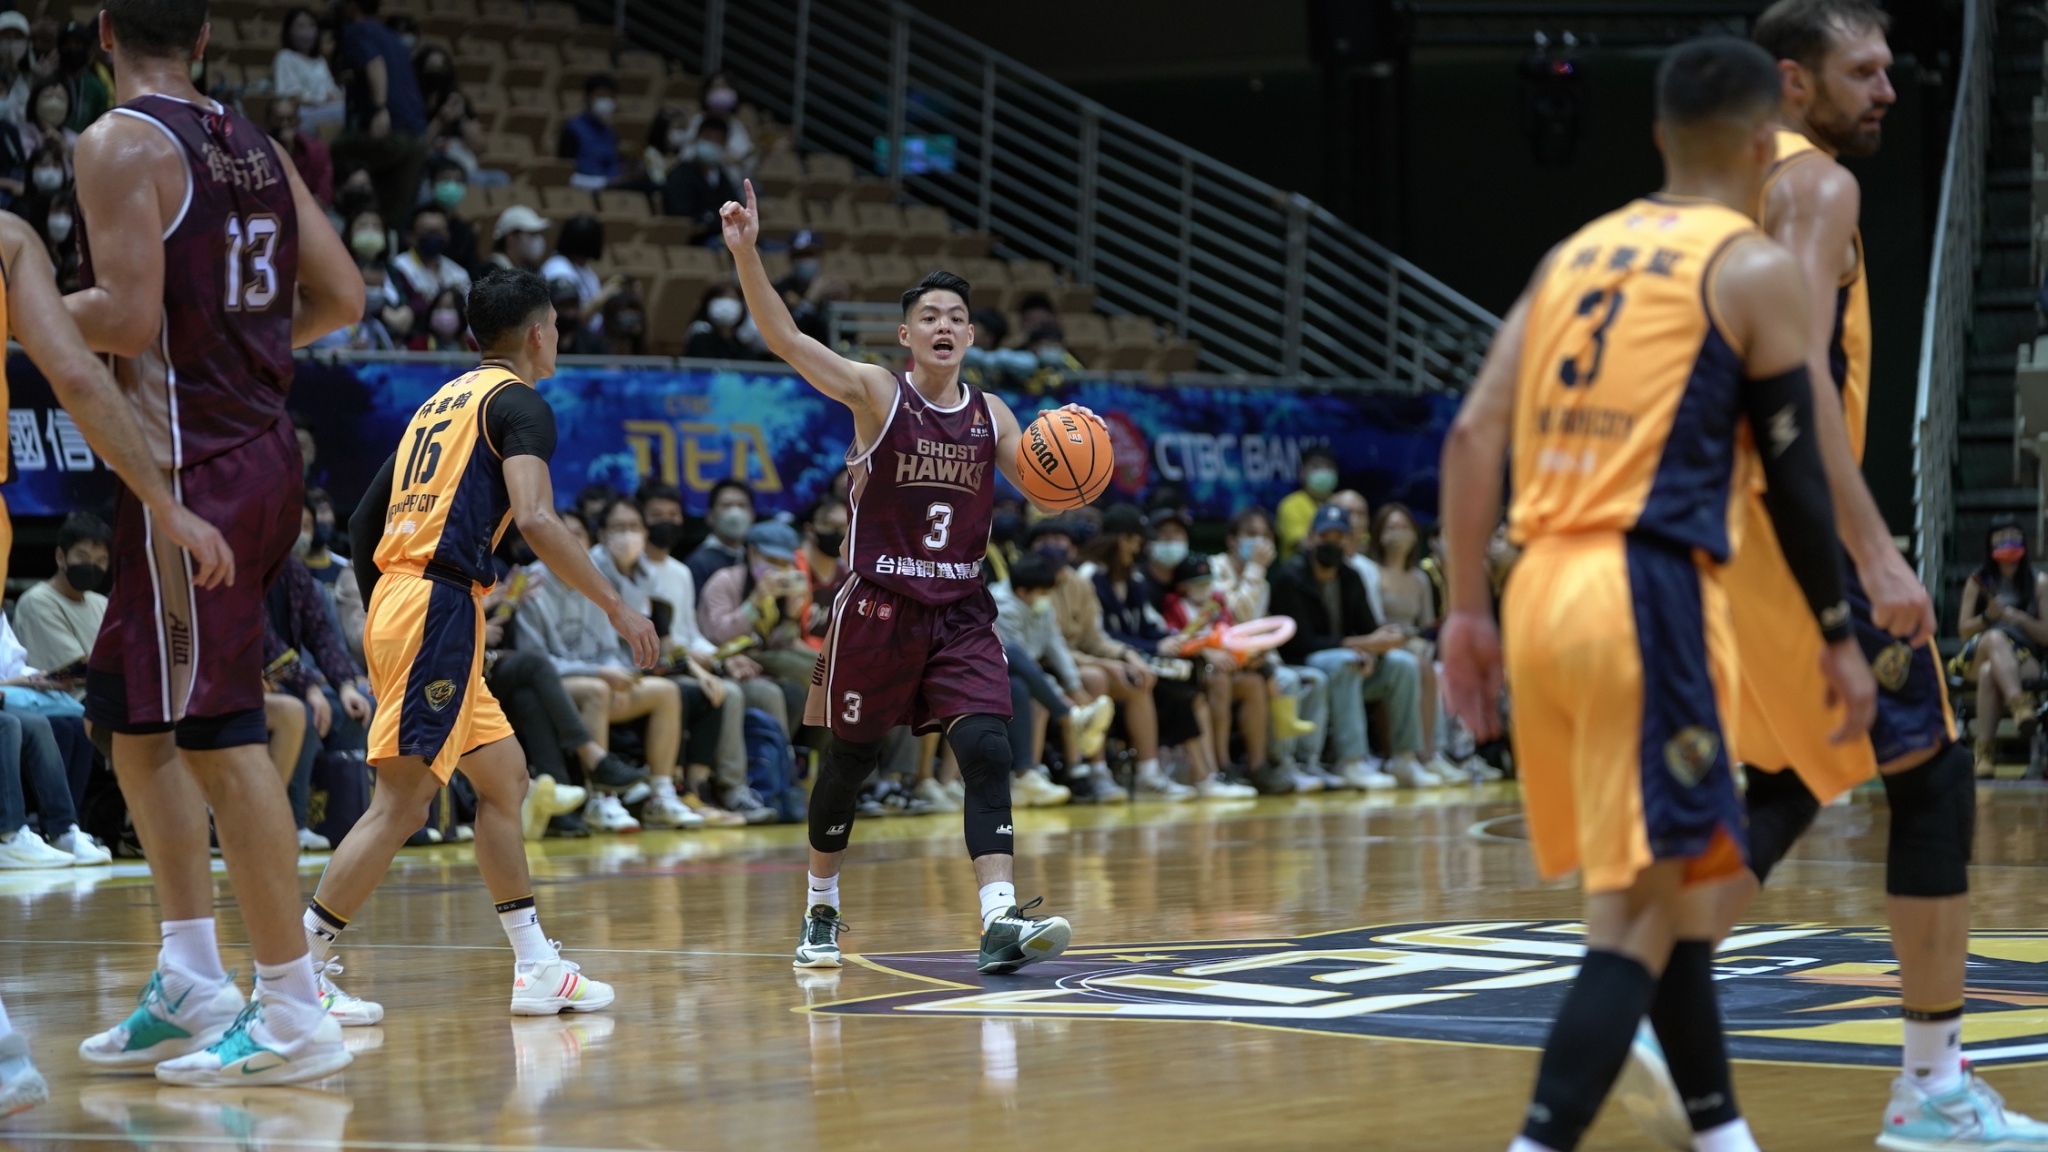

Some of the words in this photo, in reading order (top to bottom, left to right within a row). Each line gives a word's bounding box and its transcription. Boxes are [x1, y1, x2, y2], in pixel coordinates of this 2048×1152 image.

[224, 211, 282, 312] 13
[1559, 287, 1626, 389] 3
[401, 419, 453, 492] 16
[893, 450, 989, 491] HAWKS
[916, 438, 978, 461] GHOST
[1029, 421, 1060, 475] Wilson
[1154, 432, 1240, 482] CTBC
[1241, 433, 1330, 484] BAN
[922, 501, 954, 551] 3
[842, 690, 862, 724] 3
